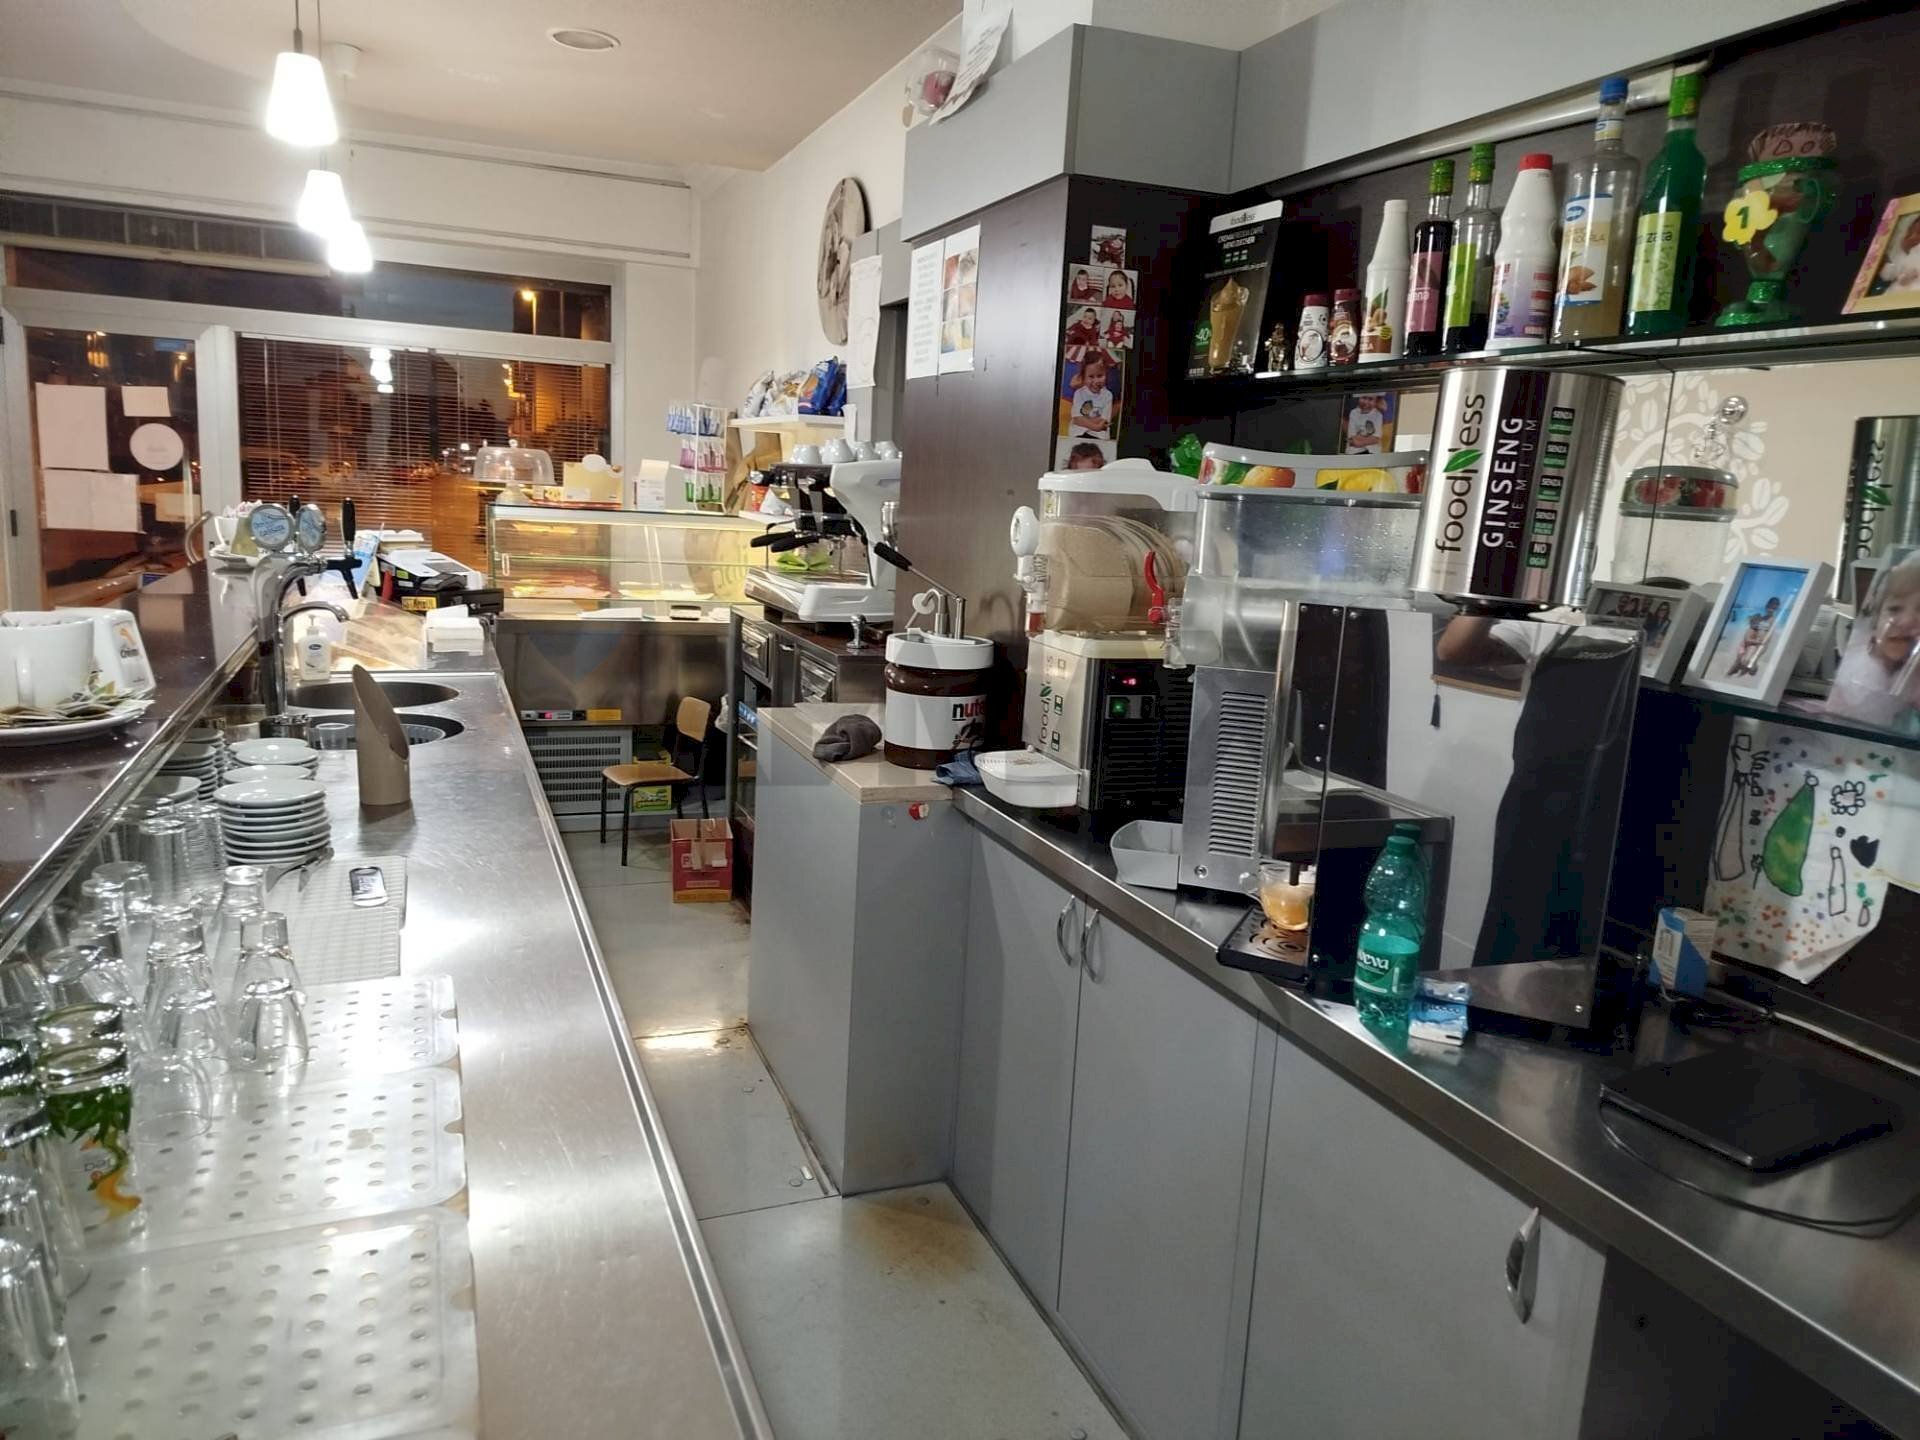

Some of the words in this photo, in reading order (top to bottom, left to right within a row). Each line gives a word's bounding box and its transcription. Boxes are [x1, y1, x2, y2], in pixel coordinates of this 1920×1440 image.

[1482, 417, 1523, 549] GINSENG
[1505, 419, 1538, 549] PREMIUM
[1533, 543, 1547, 554] NO
